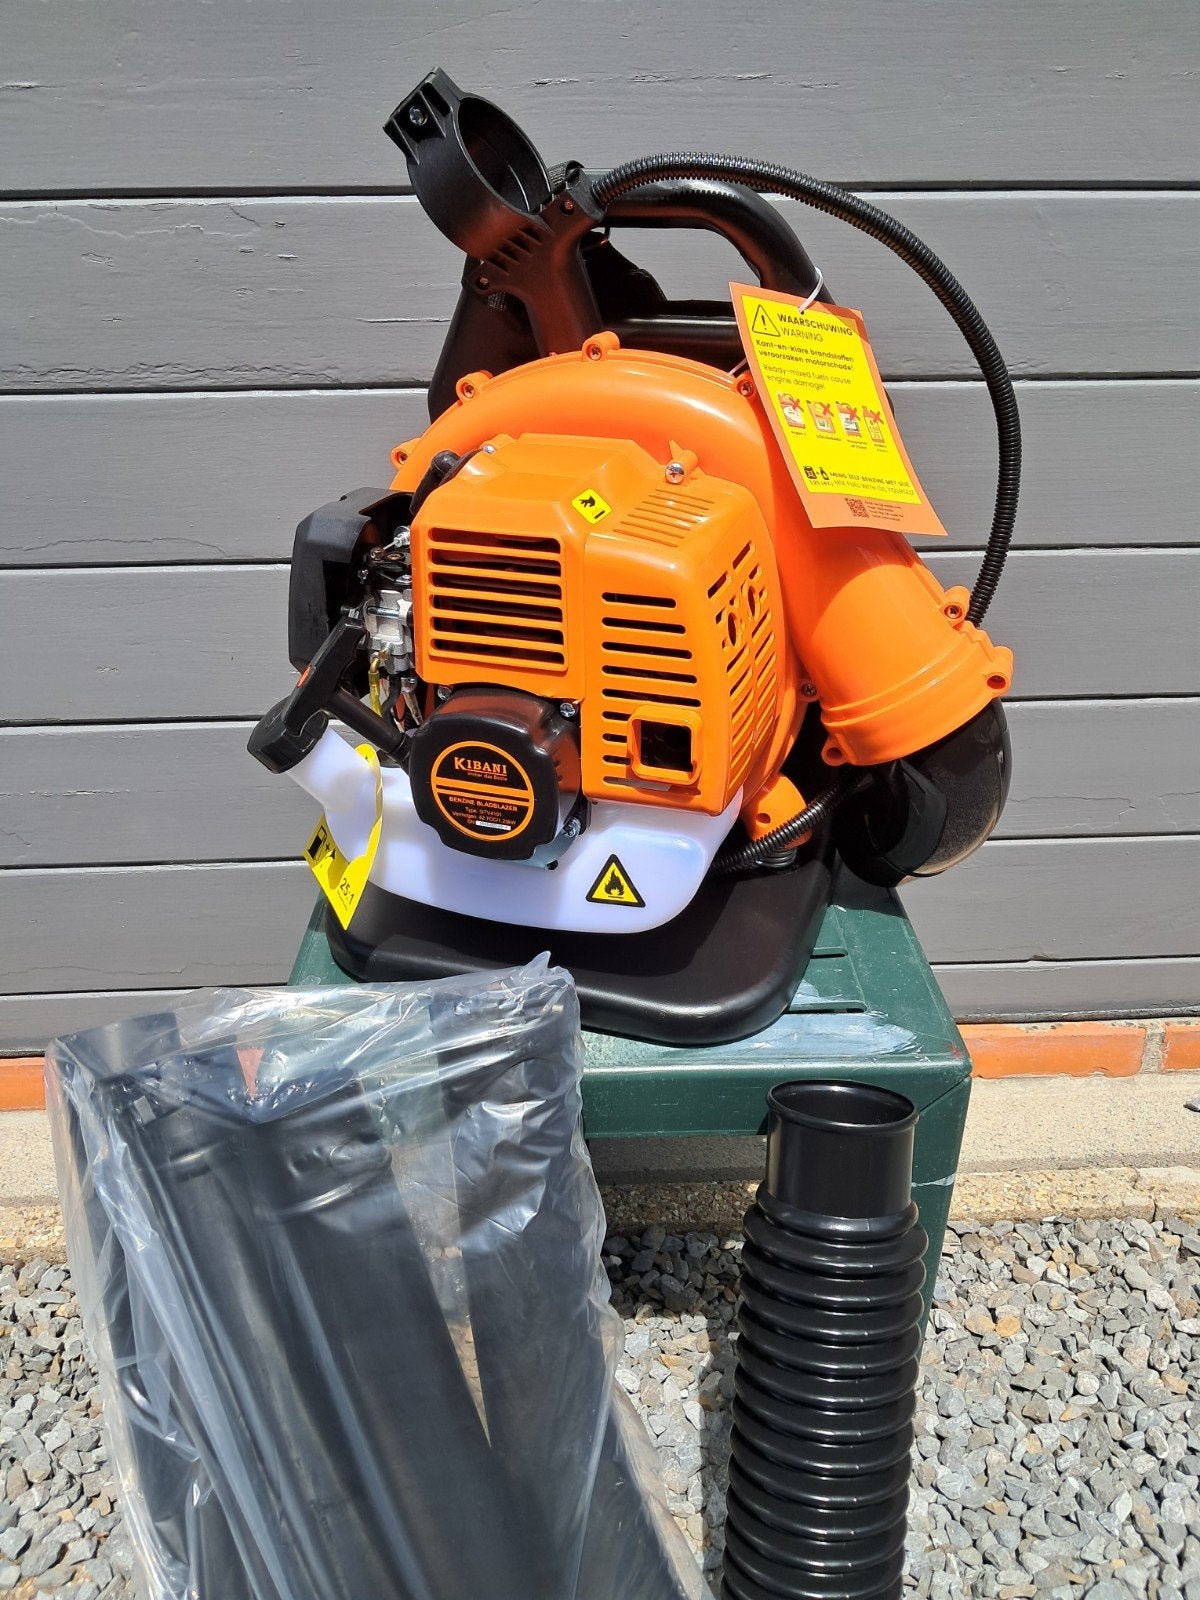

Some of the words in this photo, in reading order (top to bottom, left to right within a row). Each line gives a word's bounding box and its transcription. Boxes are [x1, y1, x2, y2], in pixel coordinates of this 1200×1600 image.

[780, 326, 824, 342] WARNING
[755, 339, 809, 354] Kant-en-klare
[809, 348, 854, 362] brandstoffen
[758, 350, 804, 362] veroorzaken
[763, 364, 812, 378] Ready-mixed
[812, 372, 829, 381] fuels
[830, 376, 851, 384] cause
[766, 375, 792, 385] engine
[454, 756, 507, 774] KIBANI
[448, 796, 475, 806] BENZINE
[476, 800, 518, 812] BLADBLAZER
